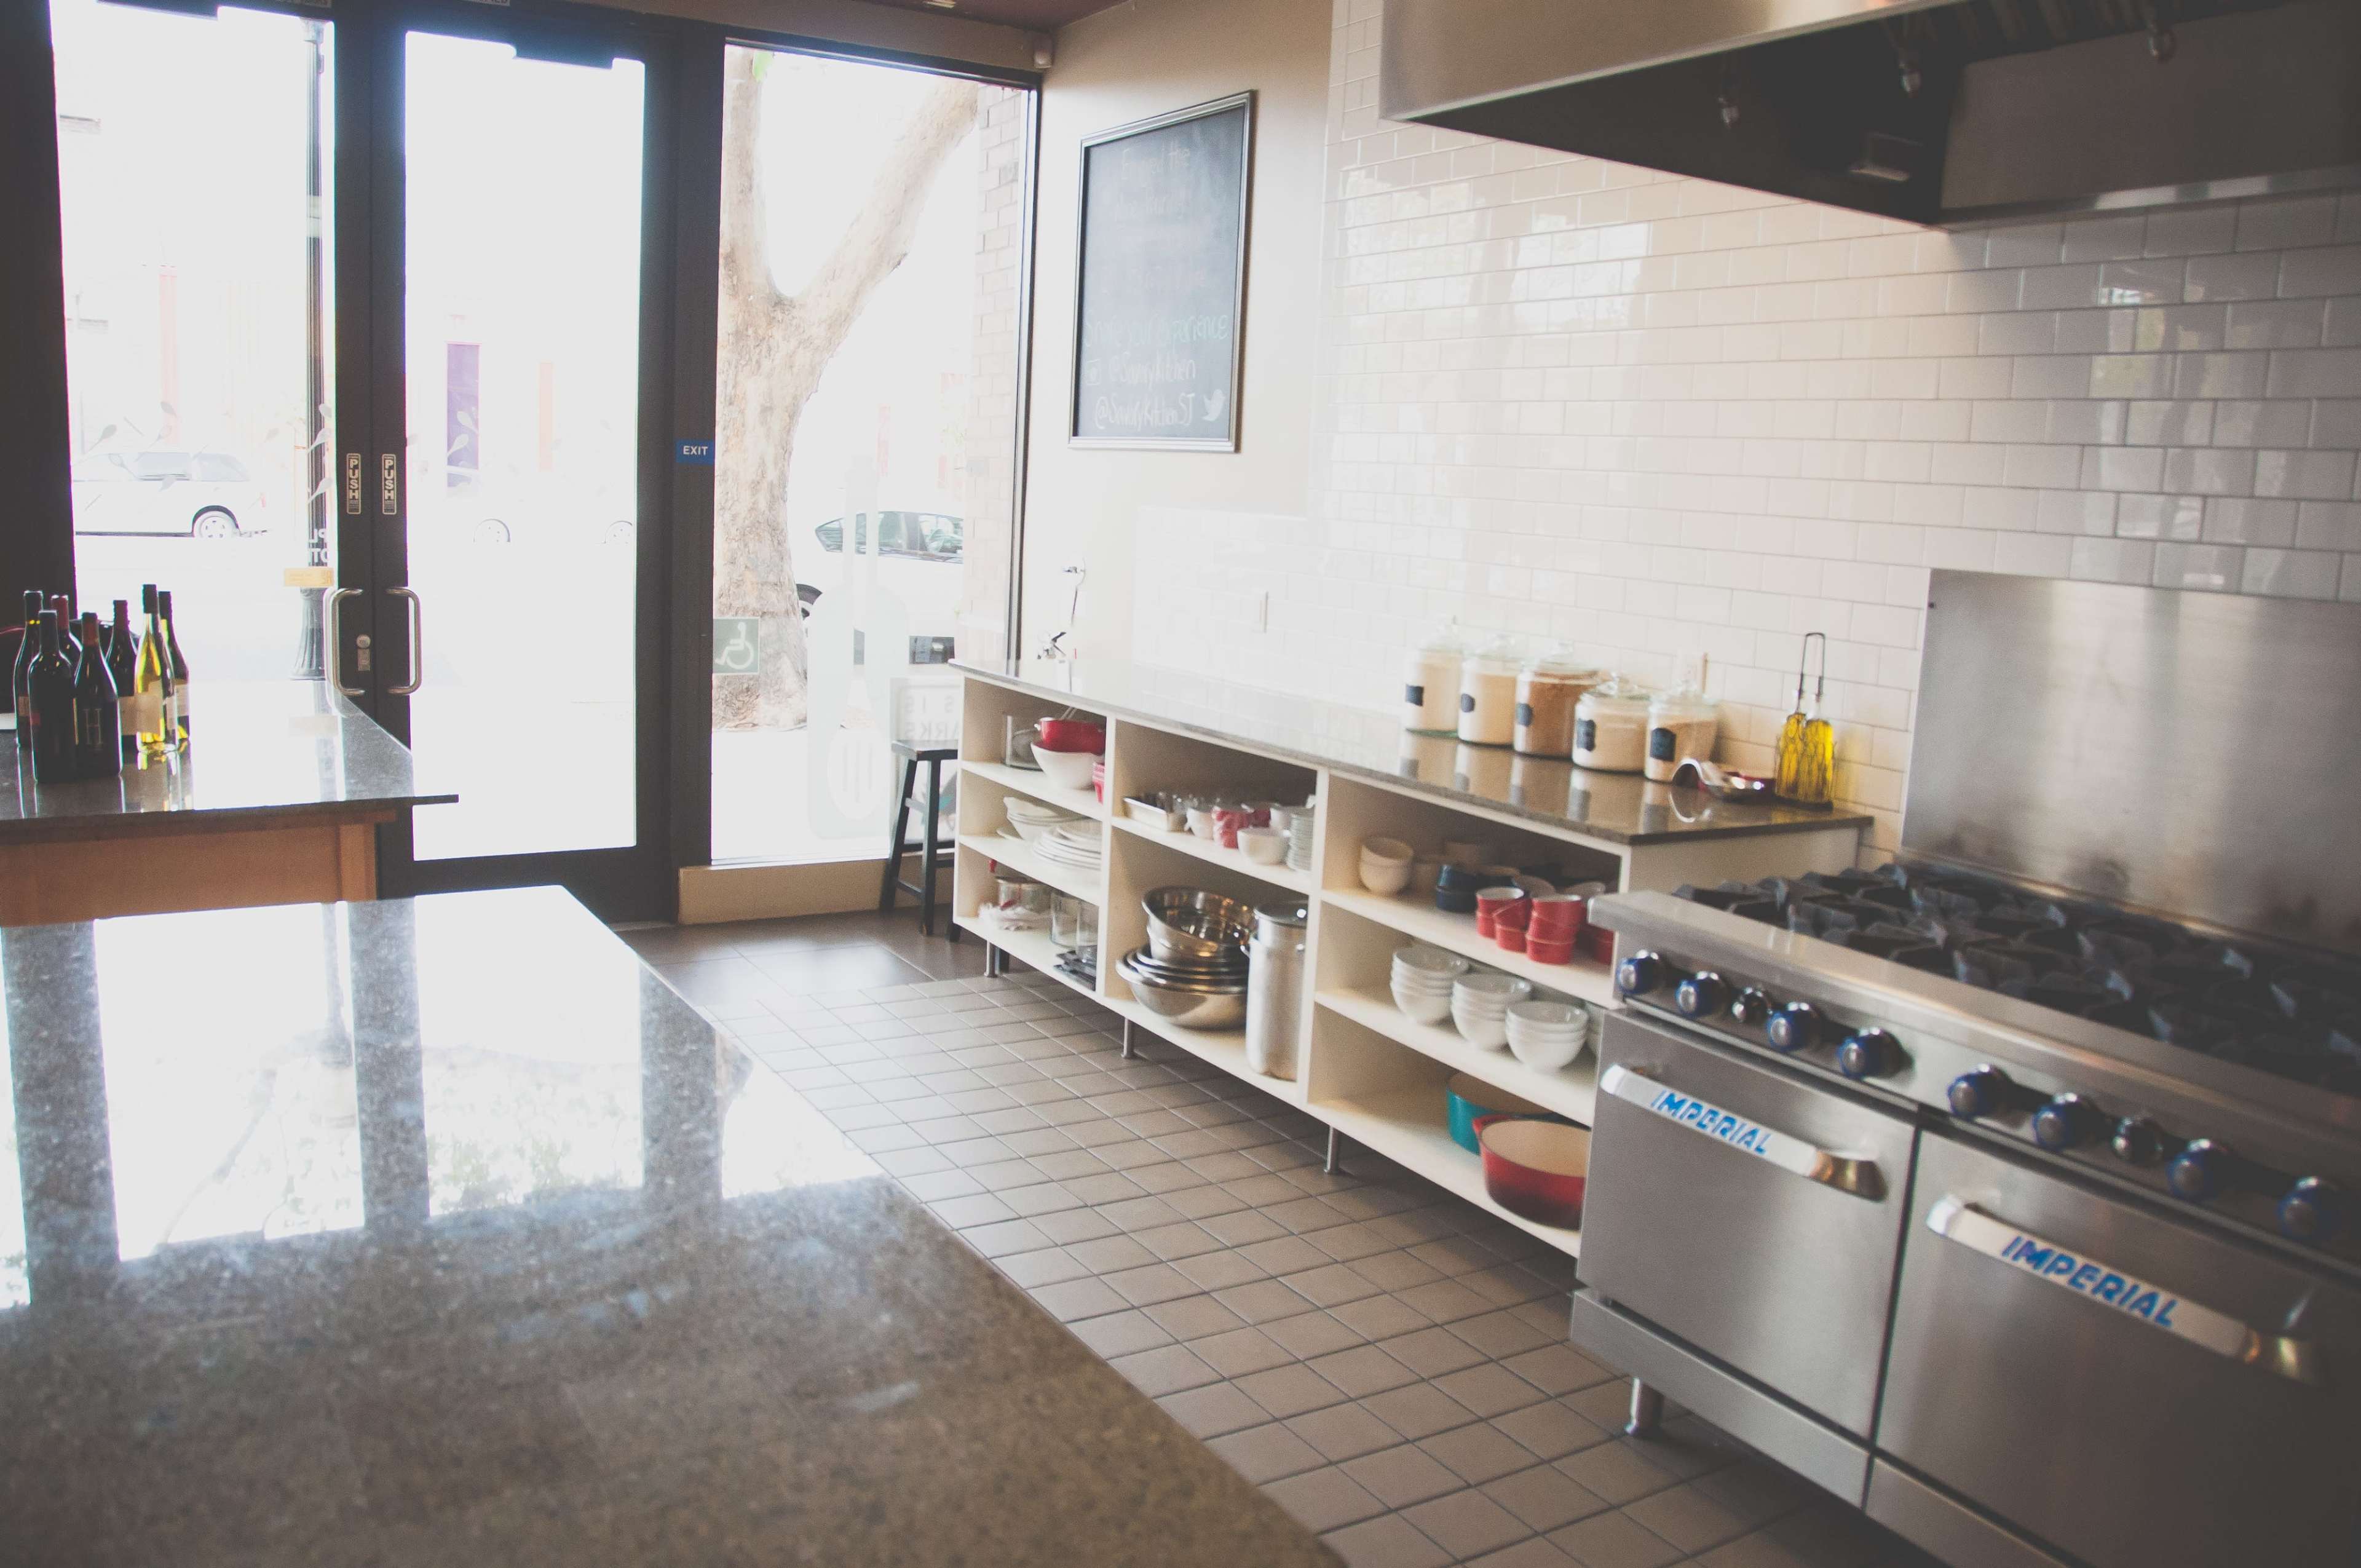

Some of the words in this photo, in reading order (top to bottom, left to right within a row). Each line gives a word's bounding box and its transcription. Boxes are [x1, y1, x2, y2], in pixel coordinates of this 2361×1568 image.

[683, 445, 708, 456] EXIT
[349, 459, 359, 499] PUSH
[384, 459, 394, 500] PUSH
[82, 708, 103, 745] H
[1650, 1090, 1772, 1155] IMPERIAL
[2001, 1235, 2182, 1328] IMPERIAL
